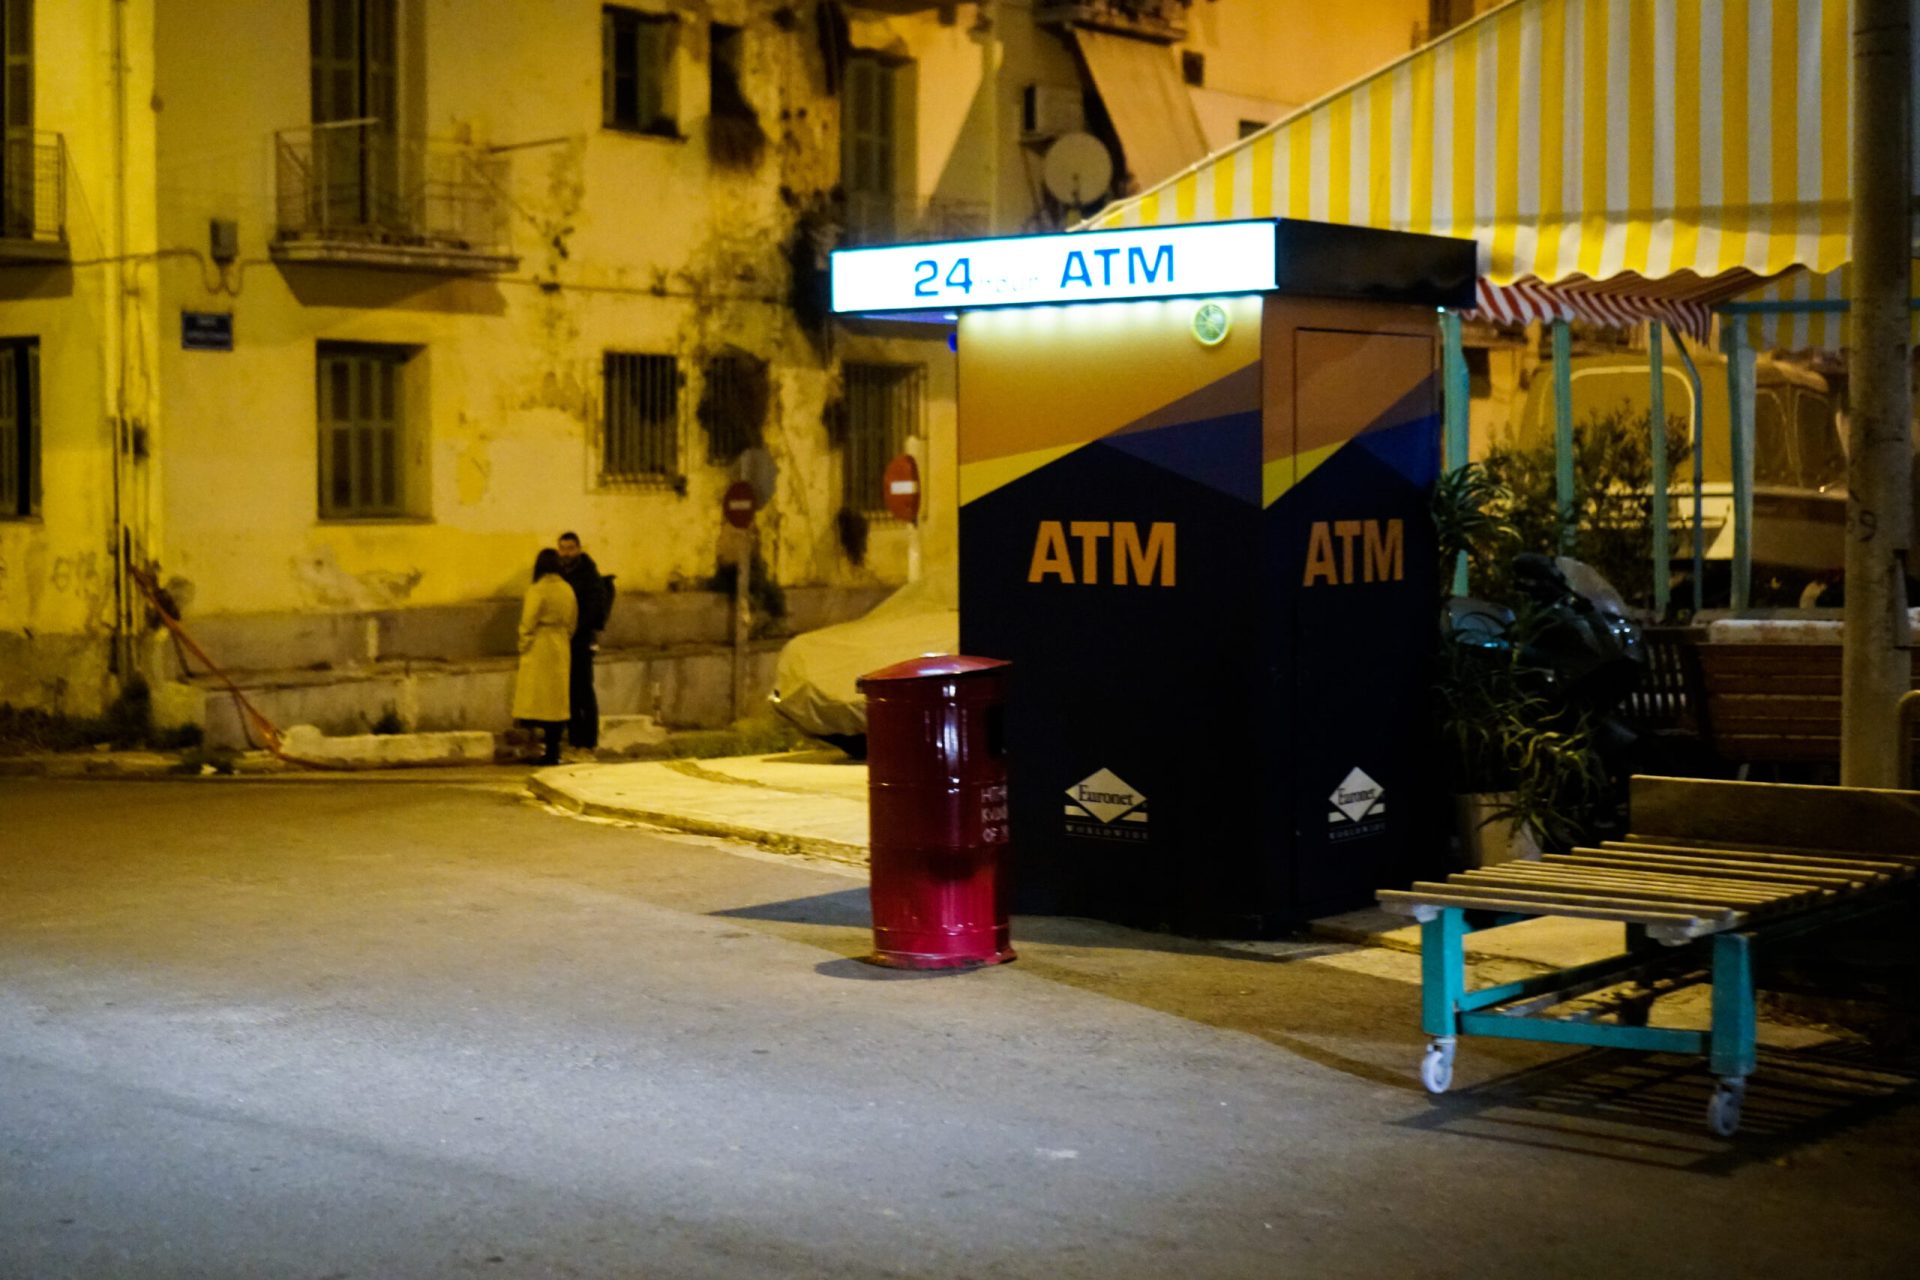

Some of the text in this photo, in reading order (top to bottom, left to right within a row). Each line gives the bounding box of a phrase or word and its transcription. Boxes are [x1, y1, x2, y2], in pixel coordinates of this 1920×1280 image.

[914, 258, 973, 298] 24
[1060, 245, 1175, 289] ATM
[1028, 520, 1176, 587] ATM
[1303, 519, 1404, 587] ATM
[1078, 784, 1134, 806] Euronet
